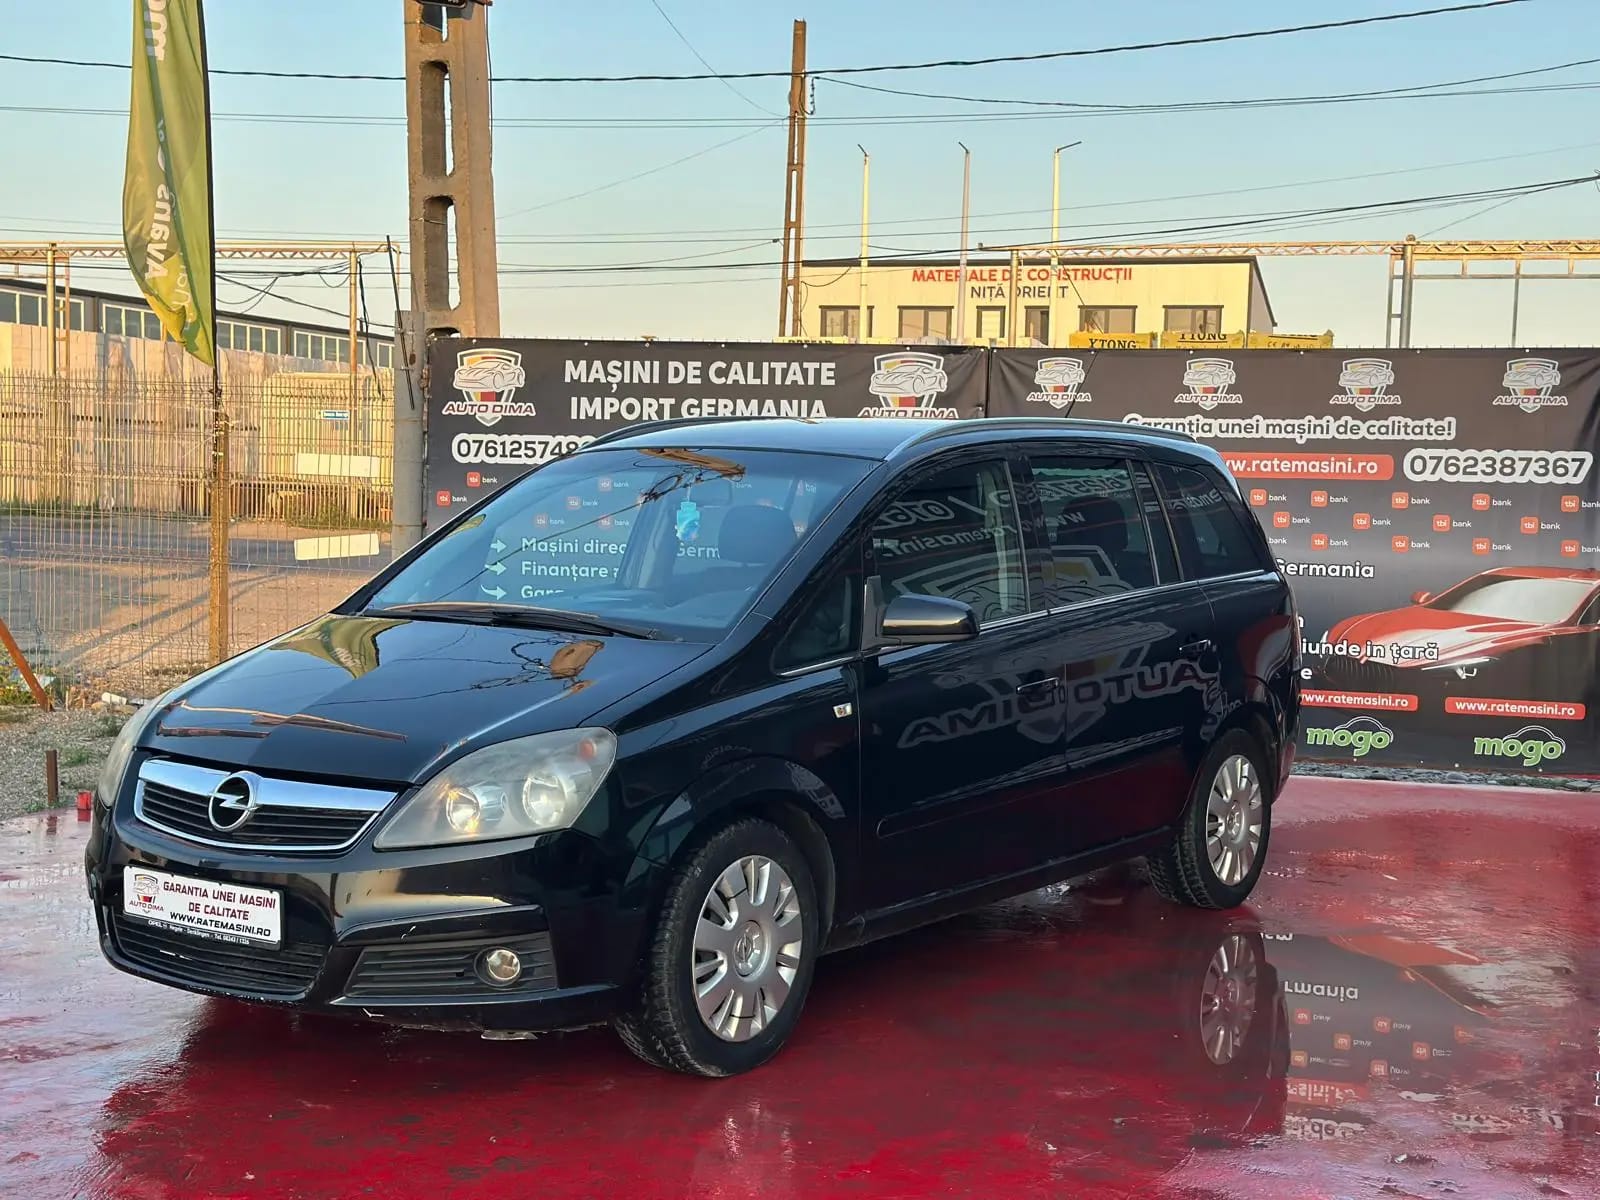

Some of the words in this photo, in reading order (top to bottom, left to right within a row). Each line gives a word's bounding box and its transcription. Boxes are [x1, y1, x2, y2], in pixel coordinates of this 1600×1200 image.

[912, 269, 998, 282] MATERALE
[1089, 338, 1137, 349] YTONG
[565, 360, 660, 393] MAȘINI
[667, 361, 703, 384] DE
[708, 361, 836, 385] CALITATE
[1027, 393, 1059, 402] AUTO
[1061, 393, 1091, 402] DIMA
[1175, 395, 1209, 404] AUTO
[1211, 395, 1242, 404] DIMA
[1330, 395, 1363, 404] AUTO
[1365, 395, 1401, 405] DIMA
[1493, 396, 1530, 406] AUTO
[1533, 396, 1568, 406] DIMA
[443, 403, 489, 414] AUTO
[491, 403, 535, 415] DIMA
[570, 397, 676, 421] IMPORT
[680, 399, 828, 418] GERMANIA
[860, 408, 908, 418] AUTO
[911, 408, 957, 418] DIMA
[1219, 419, 1260, 434] unei
[1266, 420, 1331, 440] mașini
[1335, 419, 1361, 436] de
[1366, 420, 1452, 437] calitate!
[457, 439, 596, 459] 076125748
[1409, 455, 1587, 478] 0762387367
[482, 476, 497, 484] bank
[452, 495, 467, 503] bank
[1329, 495, 1348, 503] bank
[1411, 497, 1430, 505] bank
[1372, 518, 1391, 526] bank
[1452, 520, 1472, 528] bank
[1540, 522, 1560, 530] bank
[521, 537, 579, 557] Mașini
[1411, 541, 1430, 549] bank
[1492, 543, 1512, 551] bank
[521, 561, 609, 581] Finanțare
[1276, 559, 1375, 578] Germania
[1302, 638, 1361, 656] iunde
[1366, 641, 1386, 657] in
[1390, 643, 1438, 664] țară
[1455, 701, 1576, 716] www.ratemasini.ro
[1306, 728, 1390, 757] mogo
[1473, 737, 1562, 767] mogo
[163, 881, 209, 898] GARANTIA
[212, 888, 236, 903] UNEI
[239, 893, 276, 910] MASINI
[129, 899, 147, 908] AUTO
[147, 903, 164, 912] DIMA
[188, 902, 200, 912] DE
[203, 904, 249, 921] CALITATE
[169, 911, 271, 937] WWW.RATEMASINI.RO
